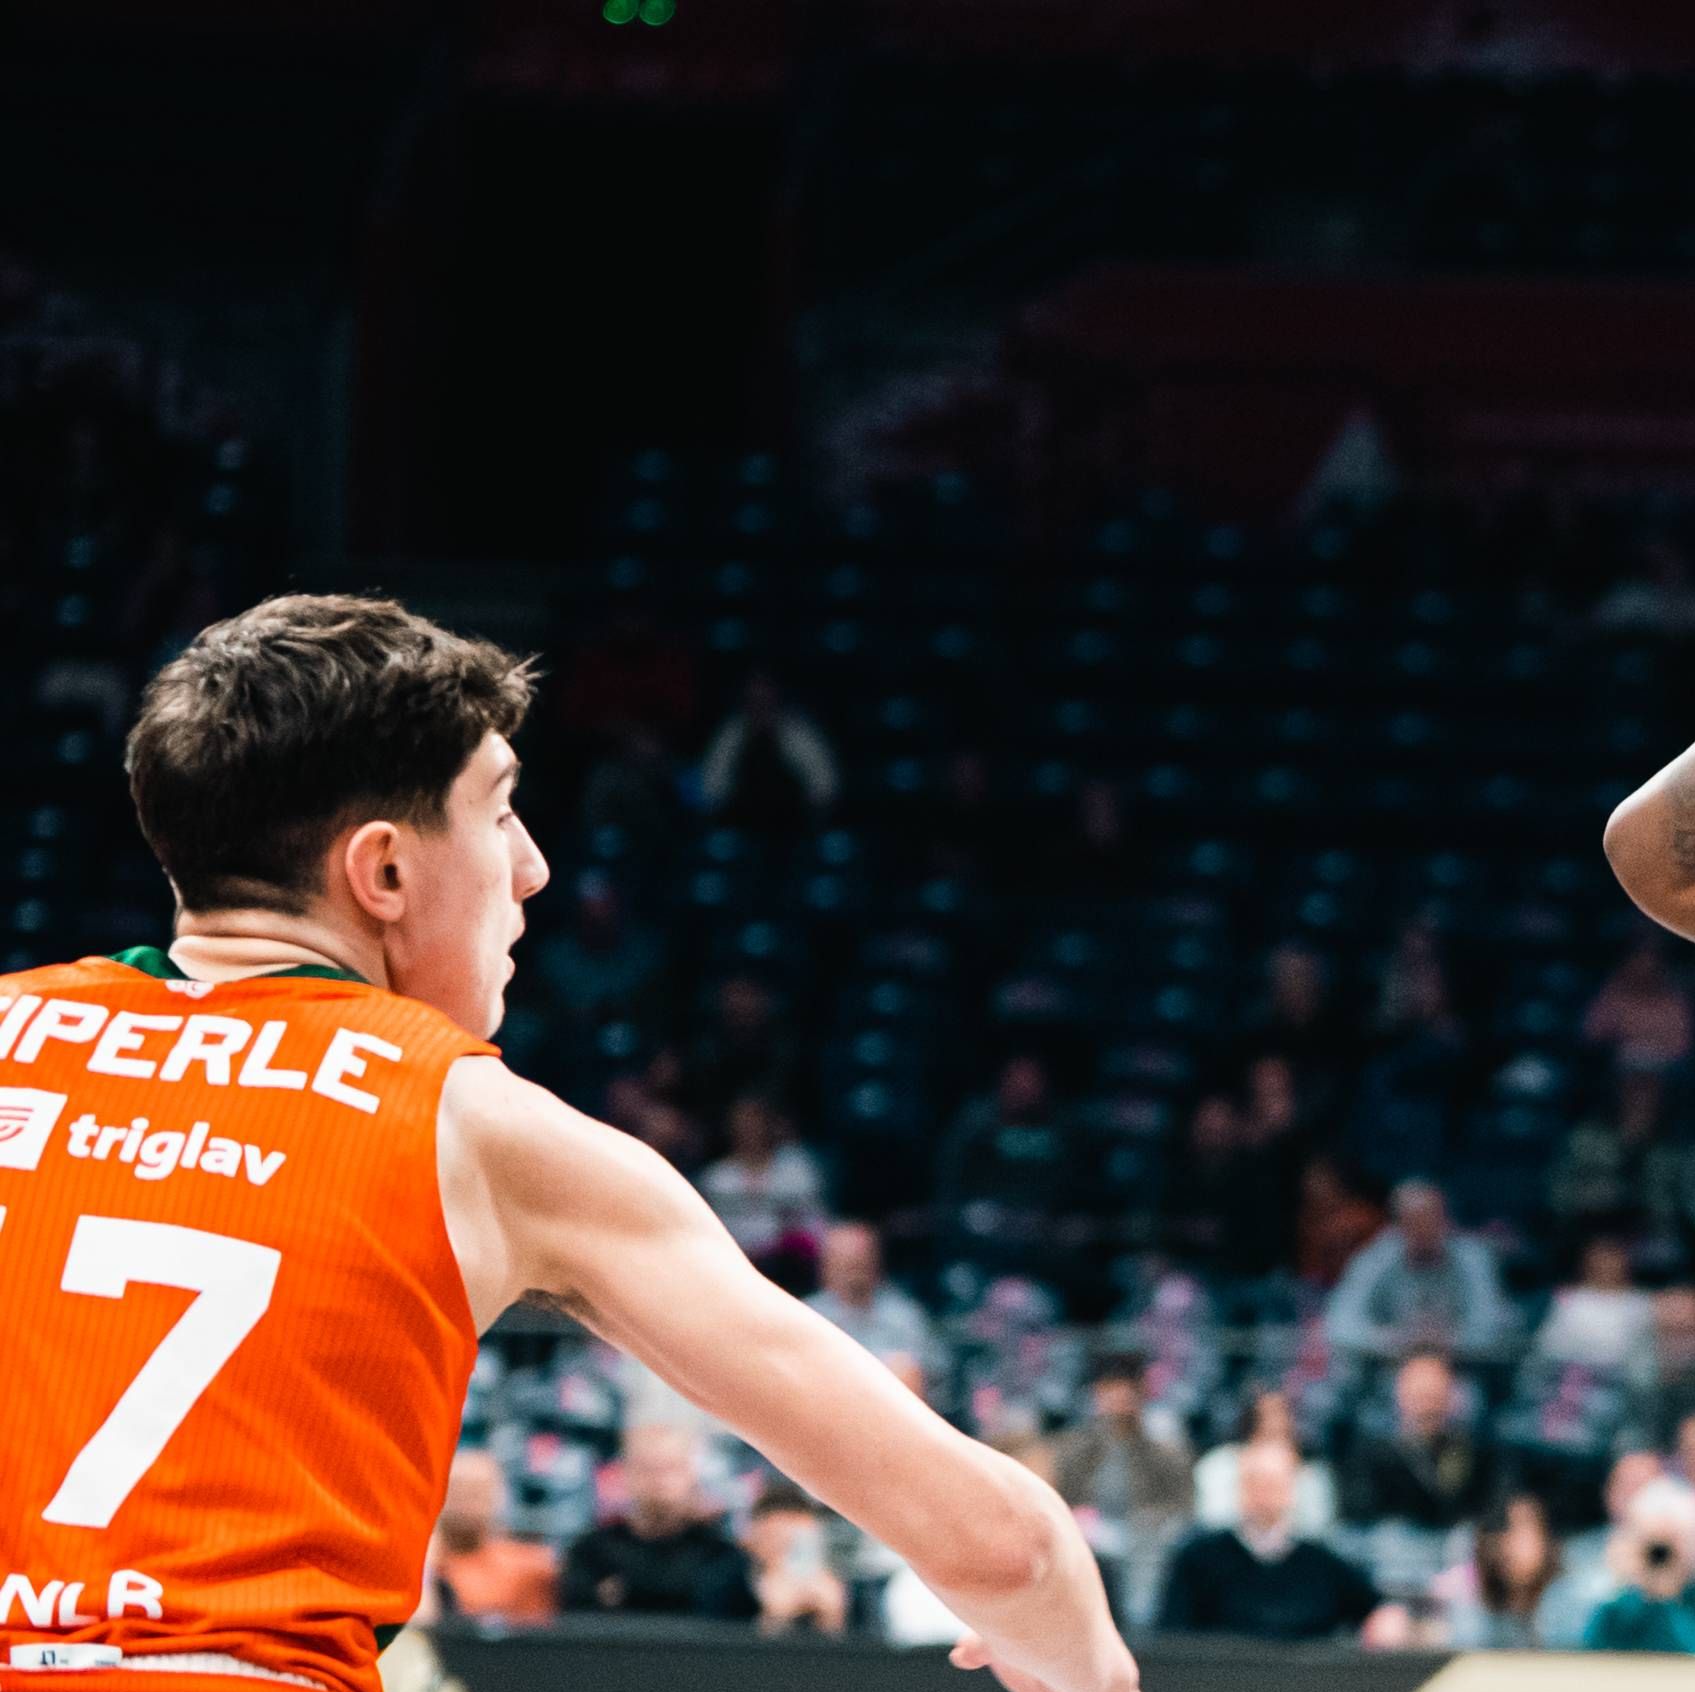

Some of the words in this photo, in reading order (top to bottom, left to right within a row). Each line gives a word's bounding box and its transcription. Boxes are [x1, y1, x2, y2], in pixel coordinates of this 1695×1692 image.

[0, 995, 403, 1114] IPERLE
[67, 1114, 287, 1186] triglav
[0, 1205, 281, 1528] 7
